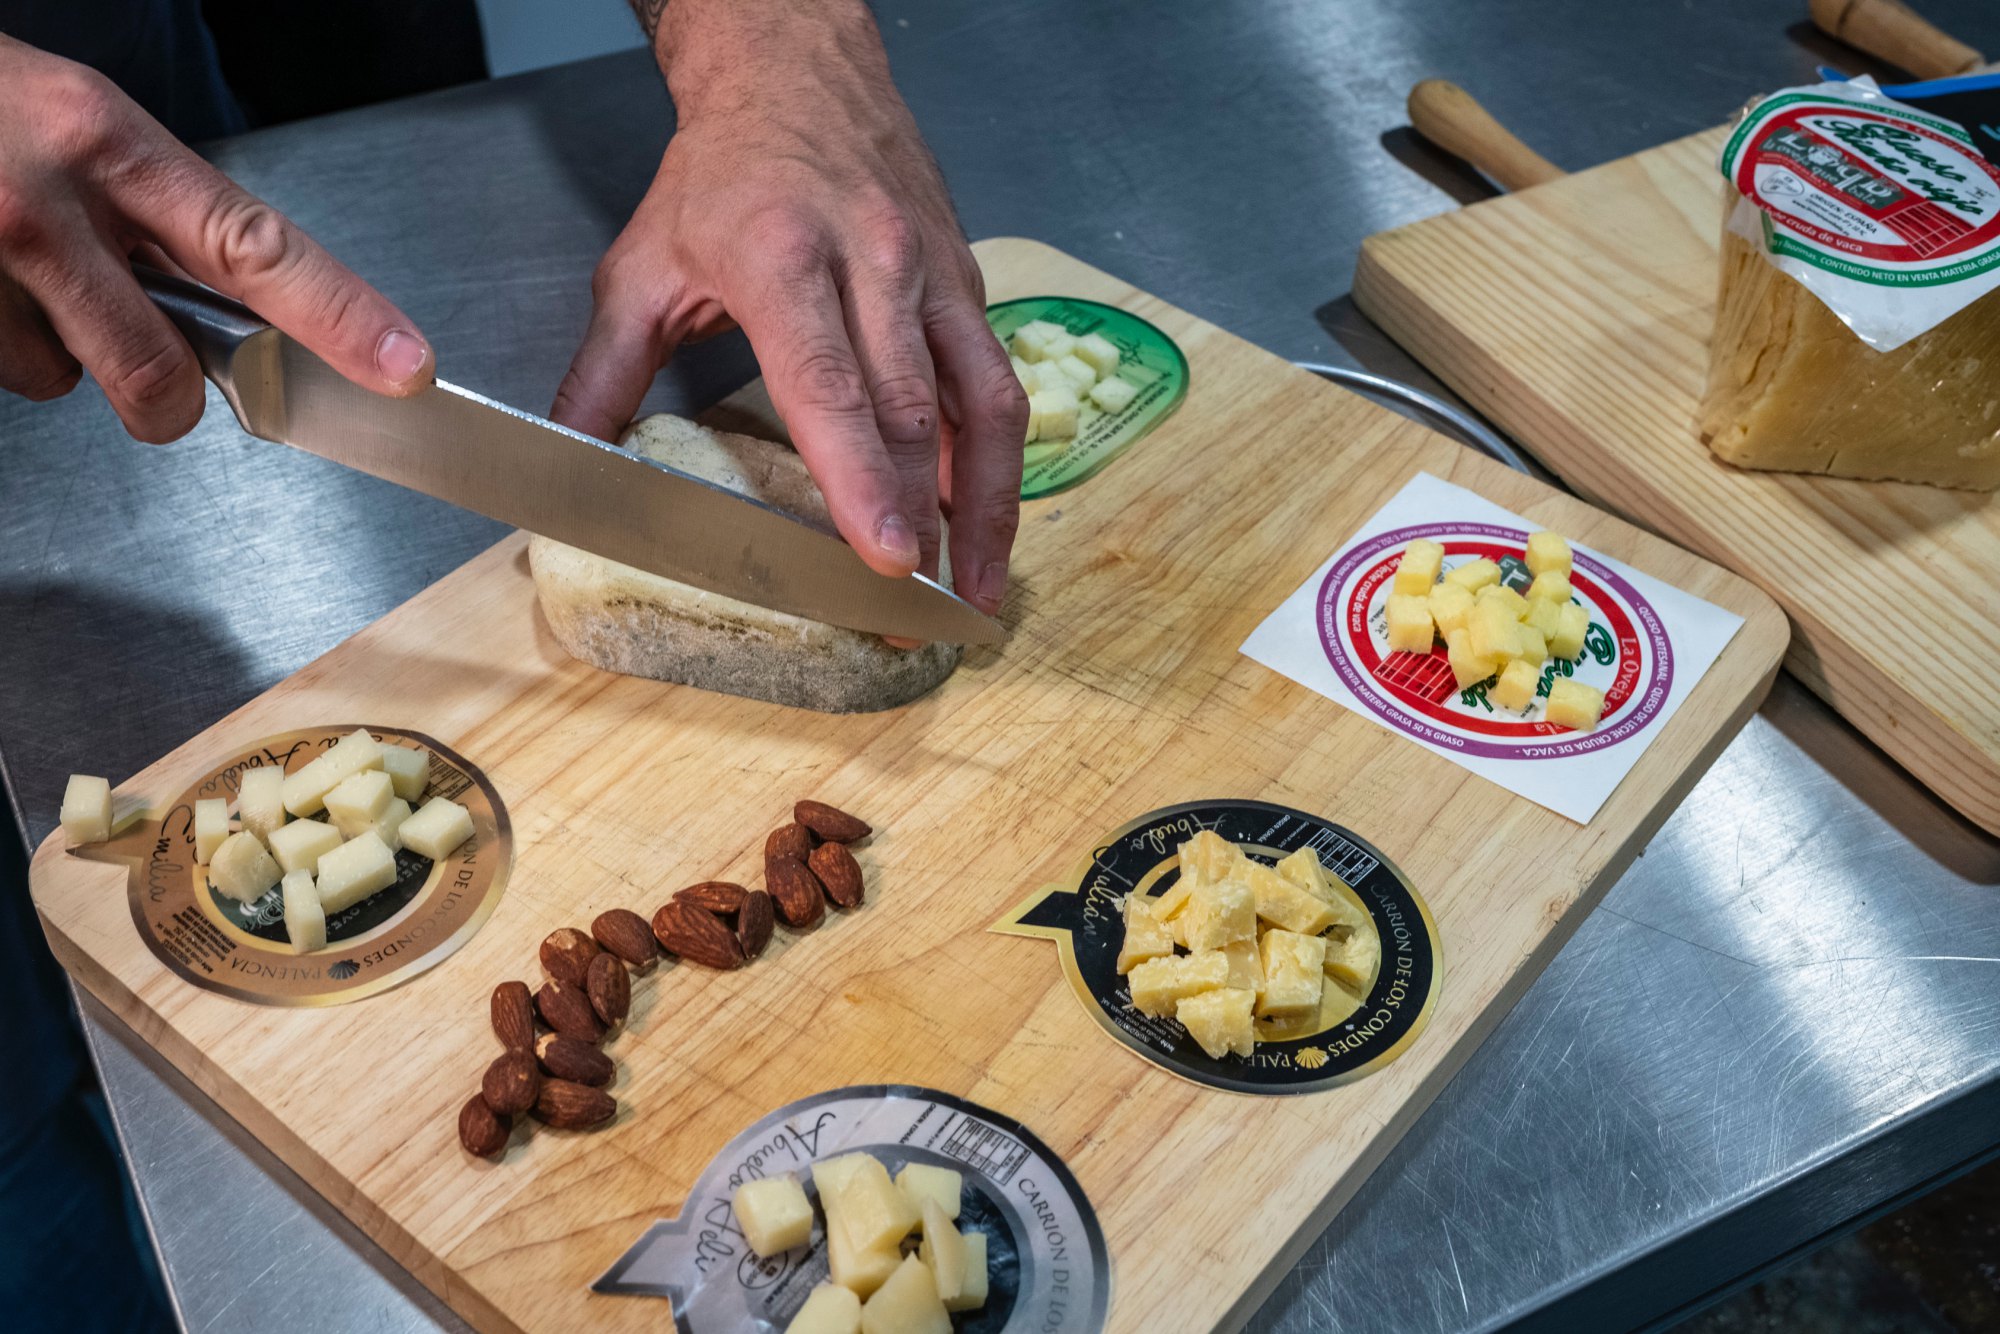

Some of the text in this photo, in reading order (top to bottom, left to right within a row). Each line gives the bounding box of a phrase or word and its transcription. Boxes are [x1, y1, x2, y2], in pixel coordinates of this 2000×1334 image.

[1786, 216, 1816, 237] cruda
[1818, 232, 1834, 244] de
[1834, 238, 1863, 253] vaca
[1819, 256, 1870, 278] CONTENIDO
[1871, 271, 1896, 282] NETO
[1897, 274, 1909, 282] EN
[1910, 270, 1940, 282] VENTA
[1940, 260, 1978, 278] MATERIA
[1368, 564, 1393, 583] leche
[1355, 582, 1373, 602] cruda
[1352, 602, 1365, 613] de
[1352, 614, 1362, 632] vaca
[1639, 606, 1661, 638] QUESO
[1328, 639, 1342, 658] NETO
[1620, 637, 1637, 657] La
[1336, 655, 1347, 667] EN
[1654, 635, 1669, 682] ARTESANAL
[1341, 662, 1360, 687] VENTA
[1609, 659, 1640, 701] Oveja
[1357, 685, 1388, 712] MATERIA
[1644, 687, 1664, 714] QUESO
[1386, 708, 1412, 727] GRASA
[1412, 722, 1425, 733] 50
[1634, 711, 1648, 725] DE
[1433, 731, 1465, 748] GRASO
[1612, 720, 1639, 739] LECHE
[1522, 746, 1557, 757] VACA
[1557, 743, 1573, 754] DE
[1574, 733, 1612, 751] CRUDA
[231, 869, 474, 982] DE LOS CONDES PALENCIA
[1369, 882, 1413, 953] CARRIÓN
[1396, 956, 1413, 978] DE
[1385, 977, 1410, 1010] LOS
[1327, 1008, 1393, 1058] CONDES
[729, 1112, 836, 1191] Abuelo
[1018, 1177, 1070, 1334] CARRIÓN DE LOS
